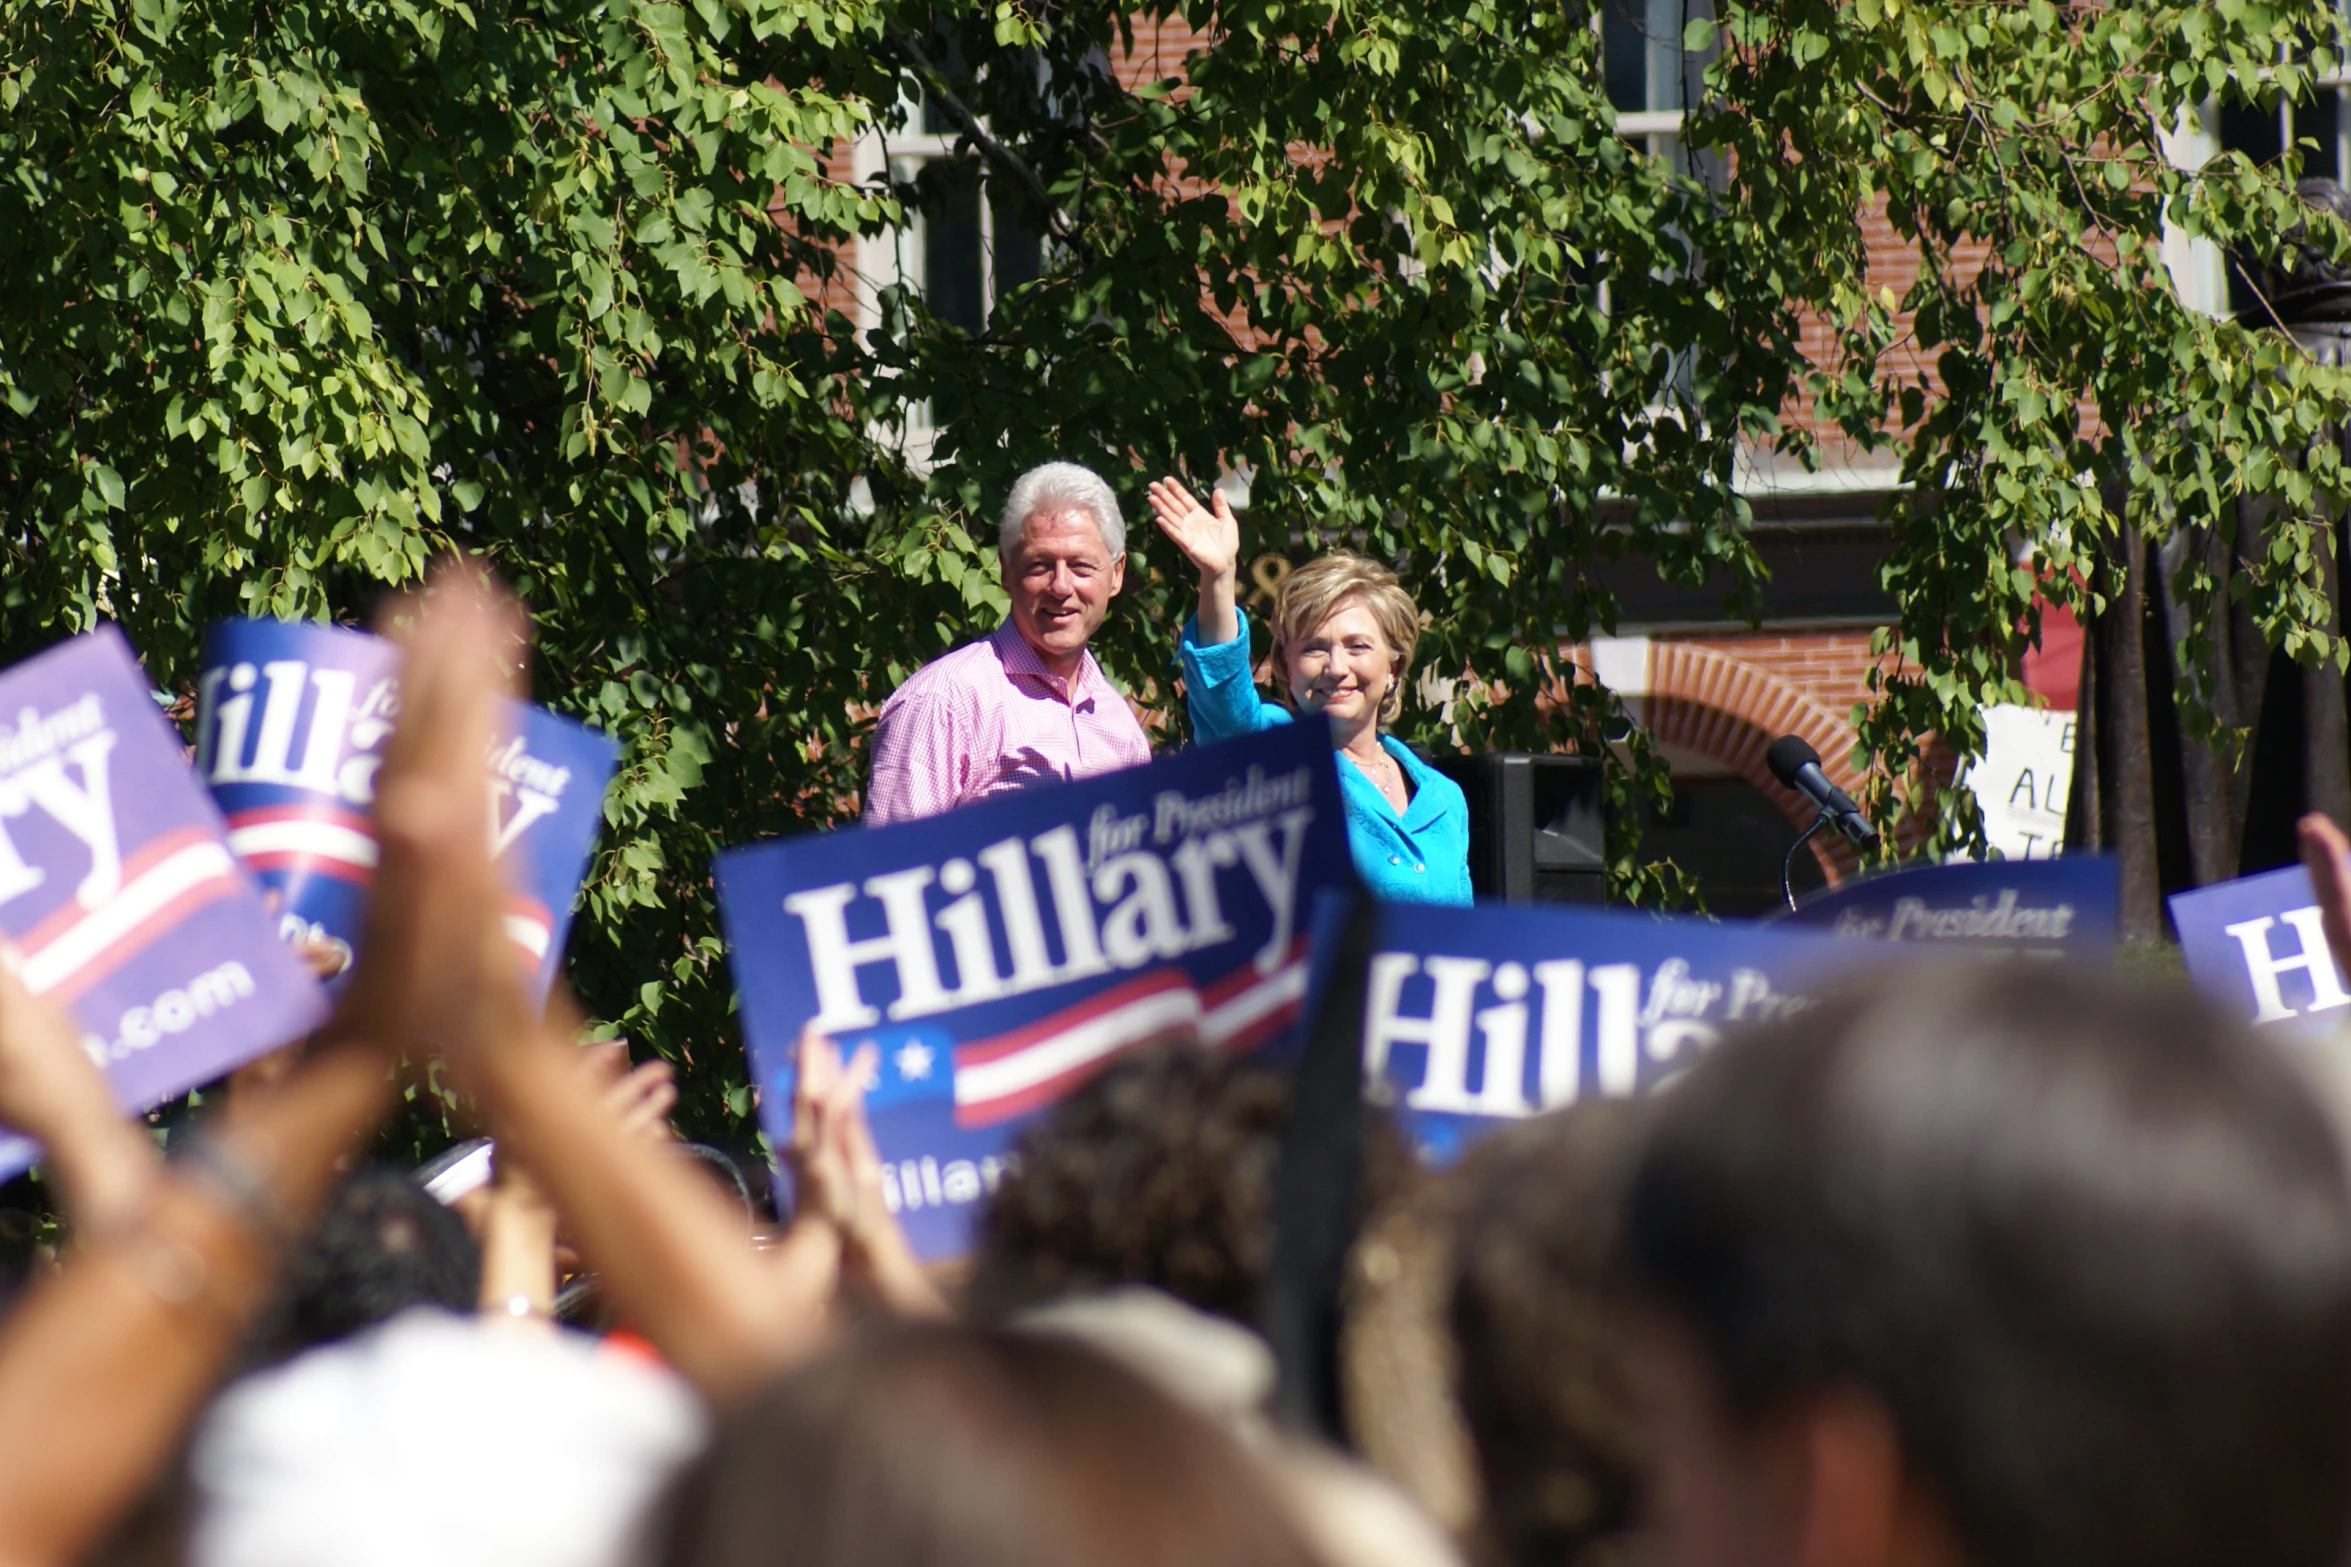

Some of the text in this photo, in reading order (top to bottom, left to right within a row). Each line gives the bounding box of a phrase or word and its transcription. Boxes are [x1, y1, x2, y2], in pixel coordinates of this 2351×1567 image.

[1088, 762, 1311, 877] for President
[784, 808, 1315, 1034] Hillary
[1888, 888, 2076, 942] President
[1638, 956, 1724, 1028] for
